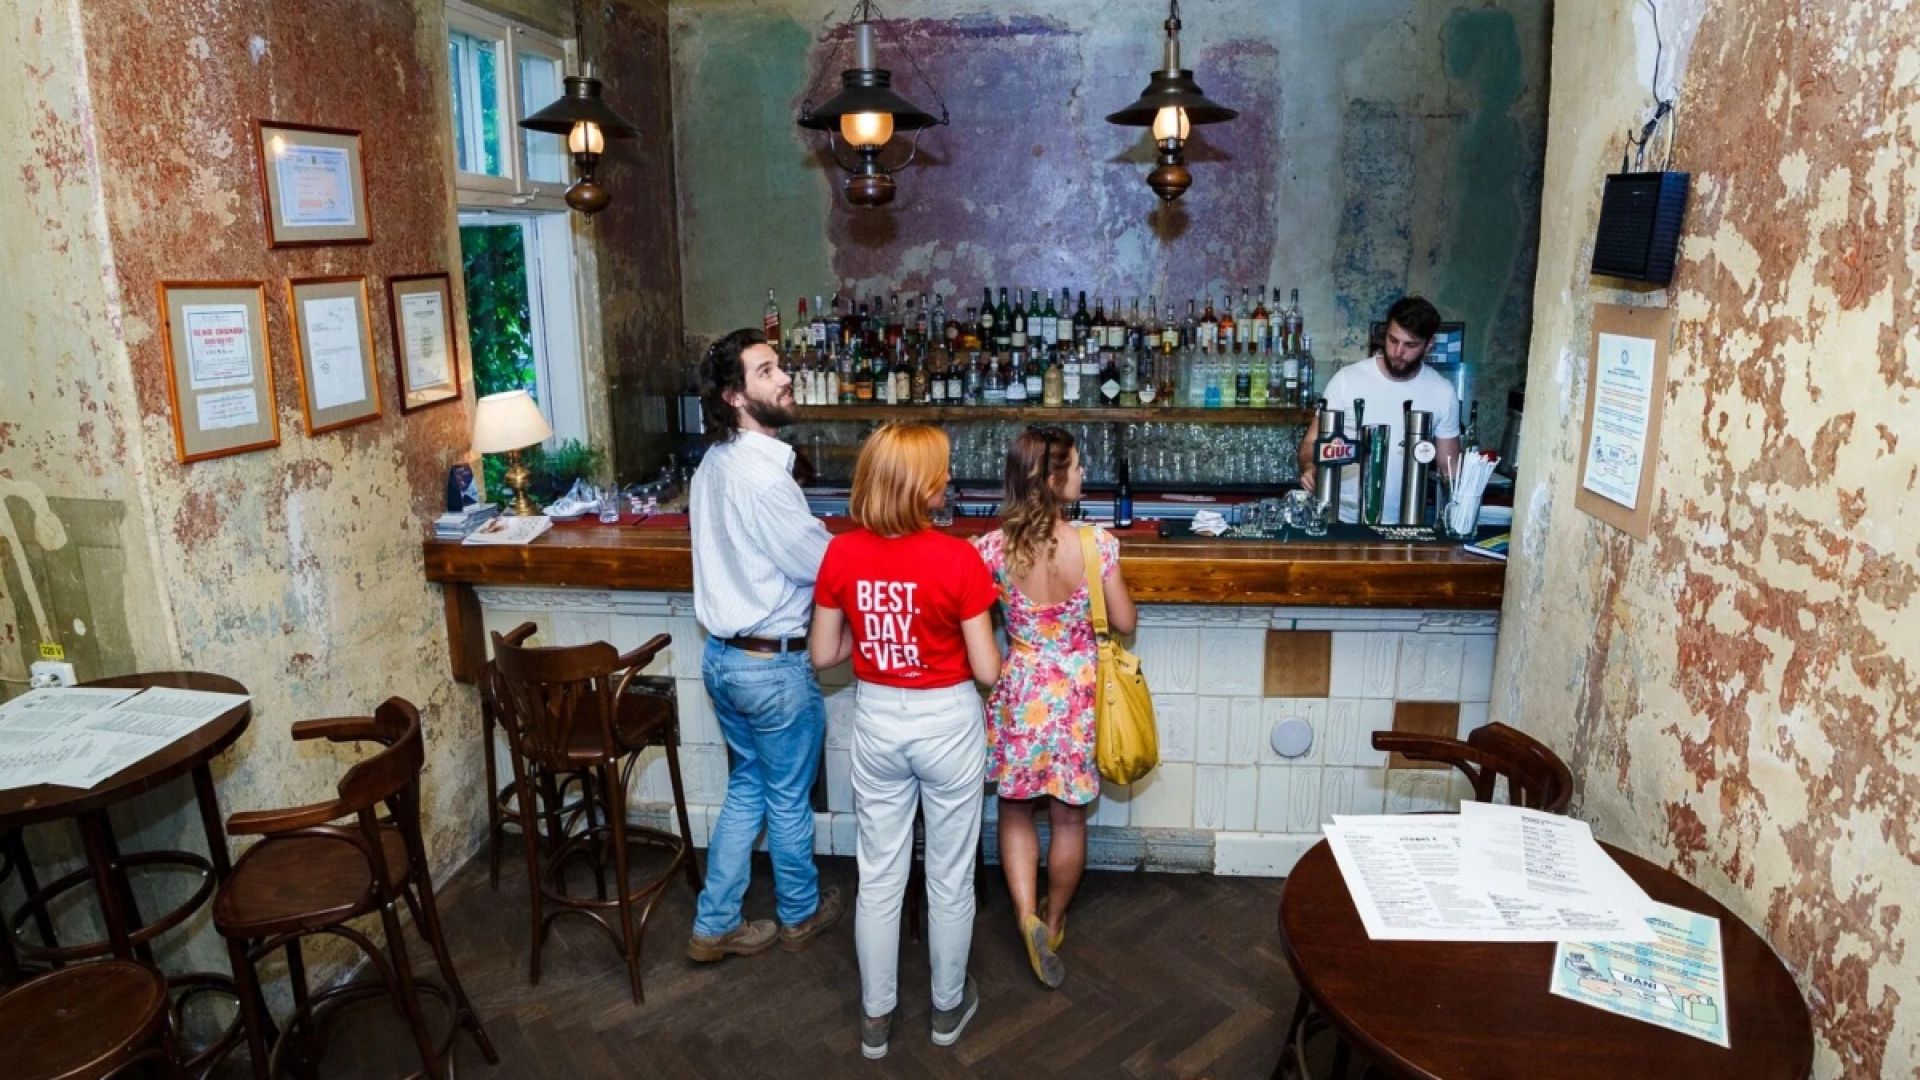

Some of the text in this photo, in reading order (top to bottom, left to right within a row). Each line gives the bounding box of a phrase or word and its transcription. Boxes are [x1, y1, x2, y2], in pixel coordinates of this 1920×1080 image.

[857, 580, 921, 614] BEST.
[864, 613, 917, 643] DAY.
[1623, 975, 1656, 990] BANI
